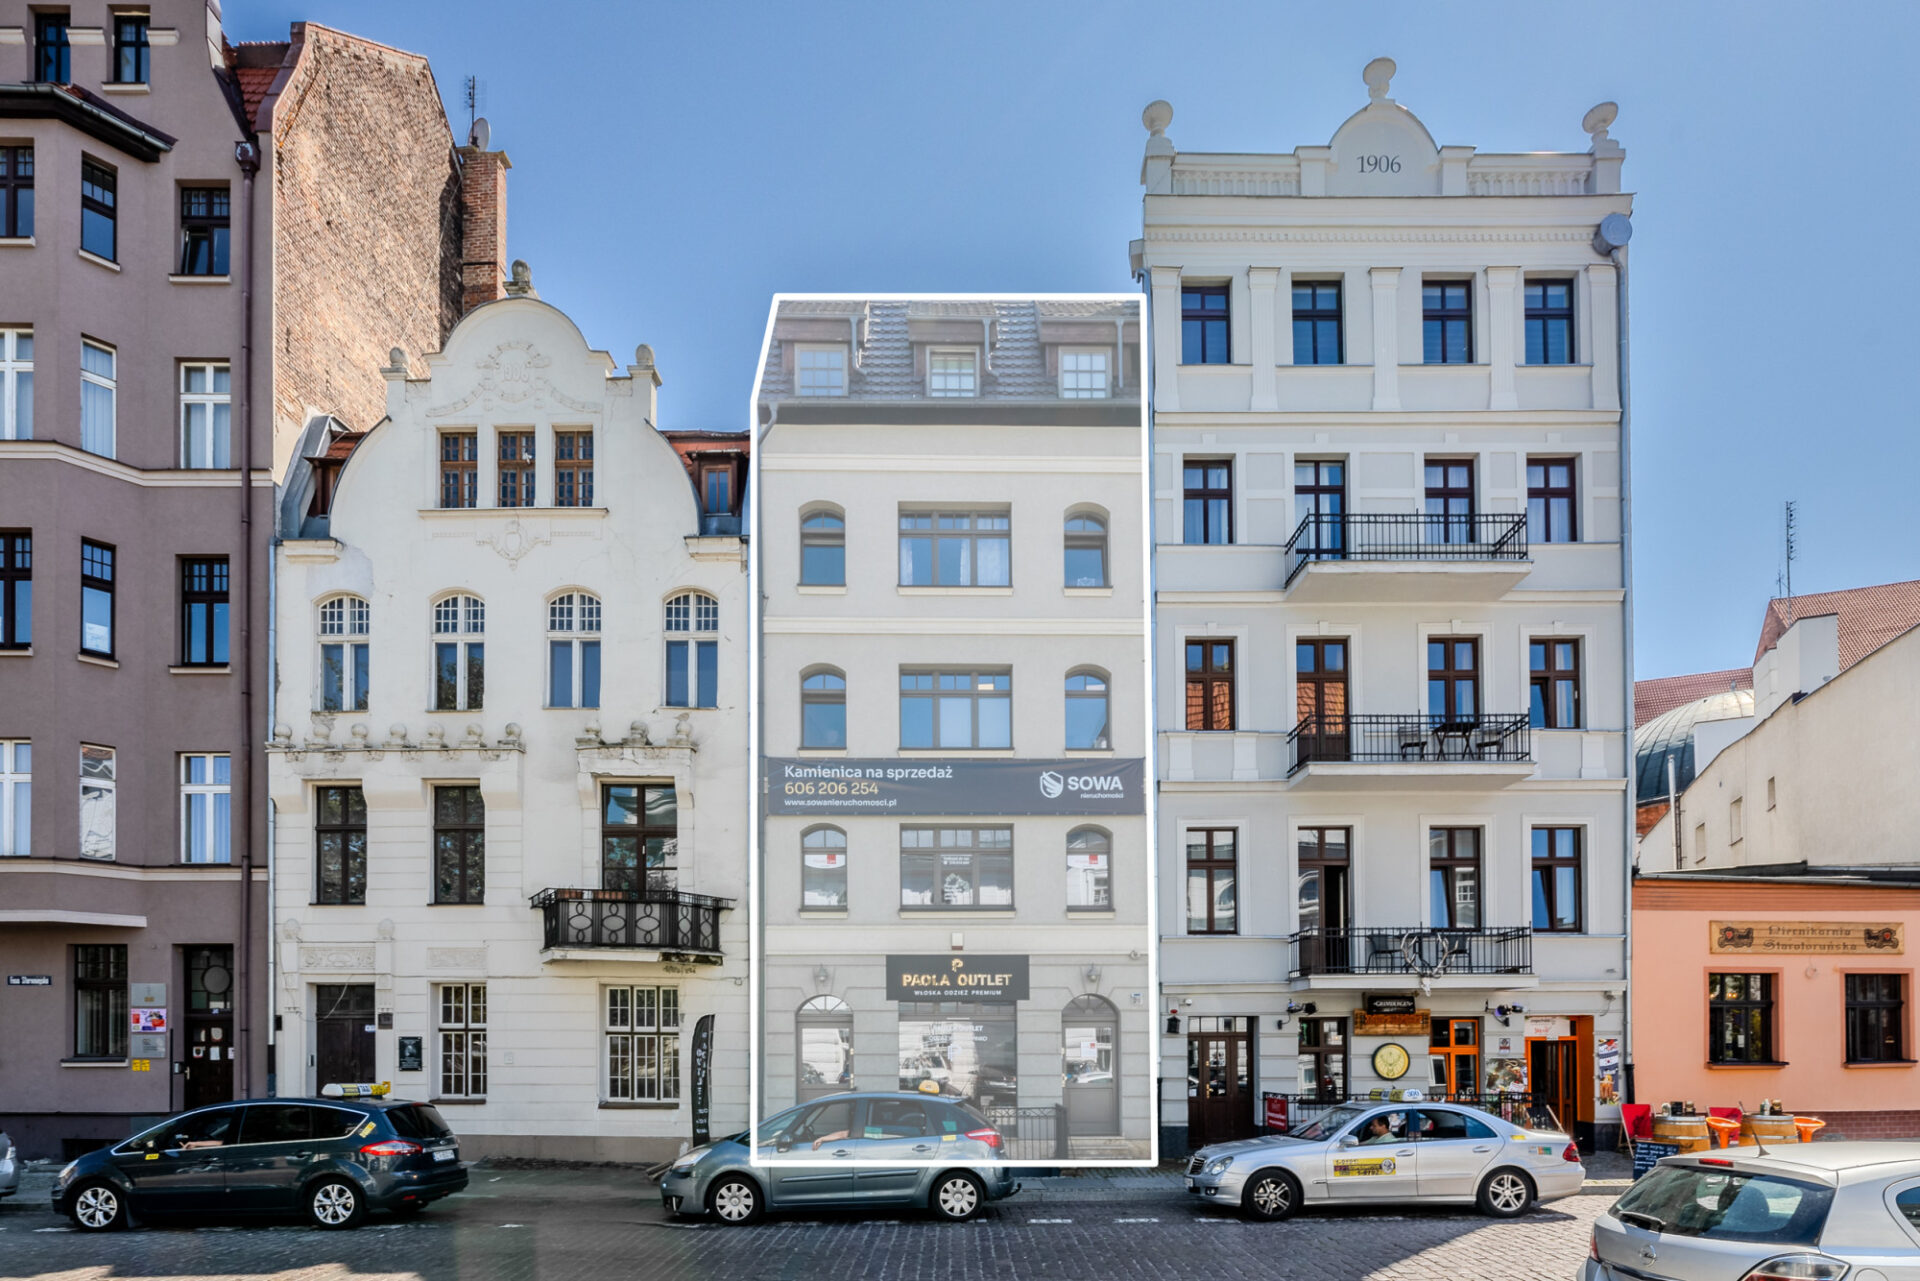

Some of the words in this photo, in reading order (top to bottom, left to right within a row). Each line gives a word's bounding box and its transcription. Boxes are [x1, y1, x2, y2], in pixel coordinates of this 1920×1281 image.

[1356, 154, 1402, 174] 1906
[784, 765, 862, 779] Kamienica
[866, 769, 884, 779] na
[887, 766, 953, 781] sprzedaż
[784, 782, 815, 795] 606
[818, 782, 848, 795] 206
[851, 782, 879, 795] 254
[1067, 776, 1124, 791] SOWA
[784, 798, 897, 807] www.sowanieruchomosci.pl
[902, 974, 951, 987] PAOLA
[957, 974, 1013, 987] OUTLET
